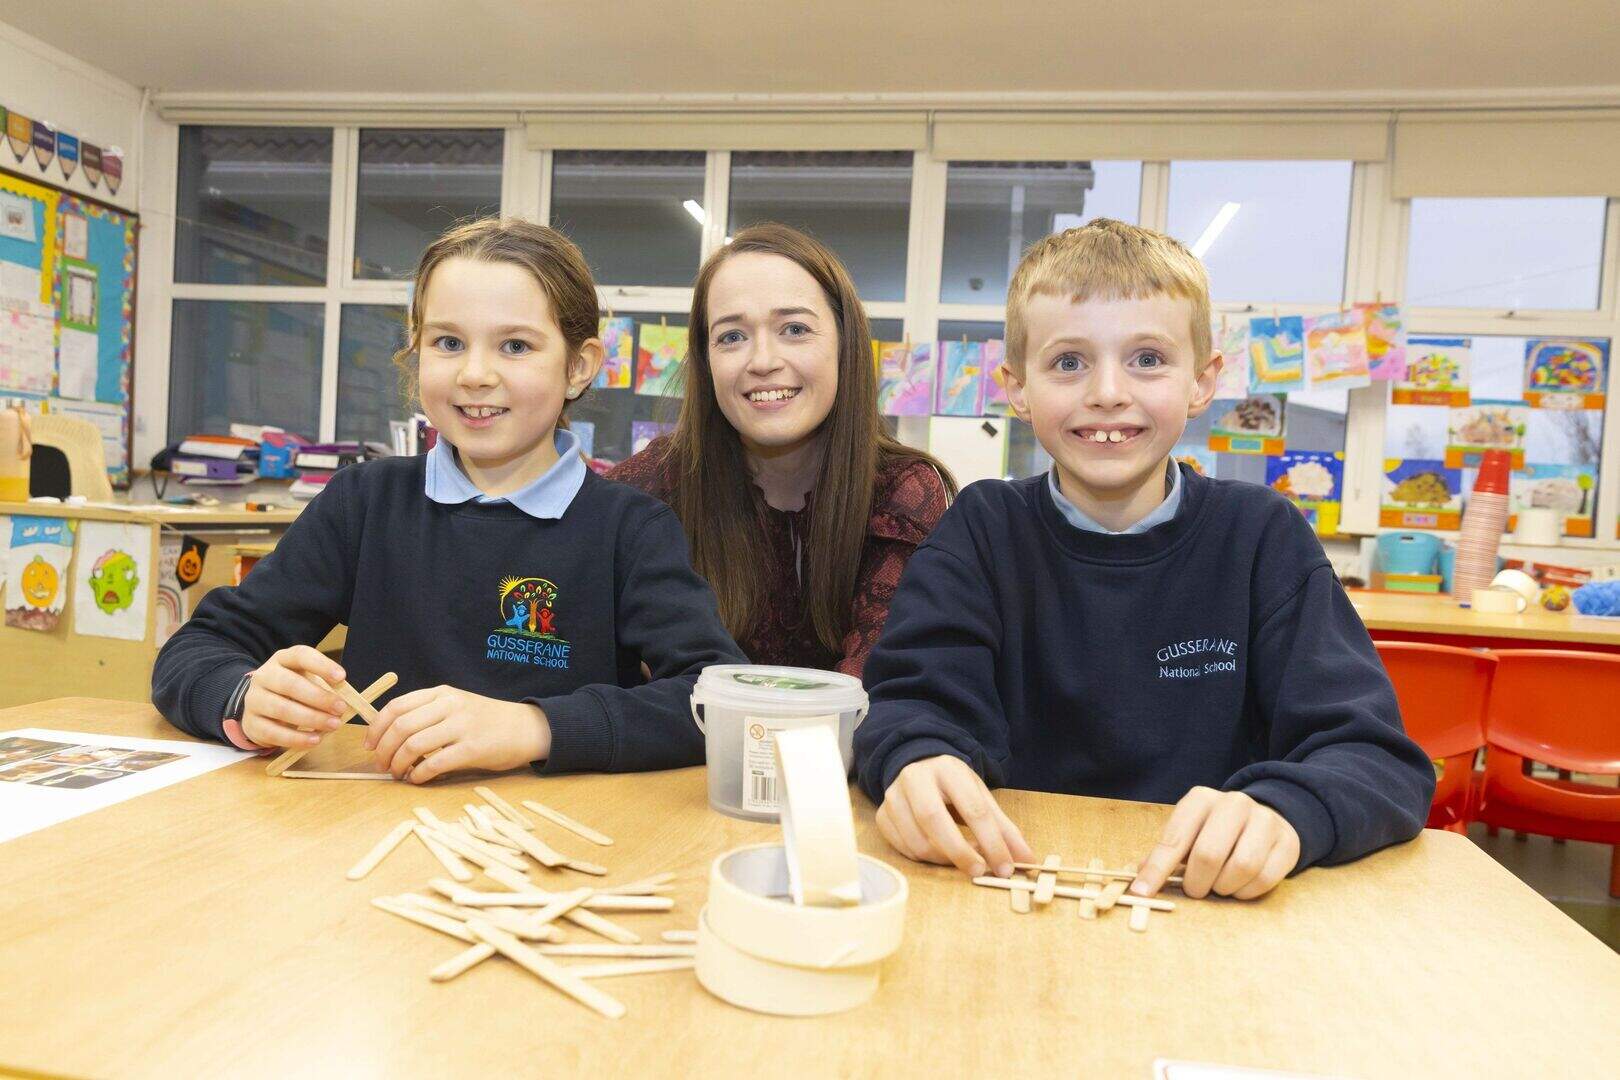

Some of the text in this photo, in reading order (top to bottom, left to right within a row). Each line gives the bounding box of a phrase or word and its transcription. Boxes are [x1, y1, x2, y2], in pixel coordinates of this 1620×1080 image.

[487, 634, 571, 659] GUSSERANE
[1156, 638, 1238, 662] GUSSERANE
[487, 649, 569, 669] NATIONAL SCHOOL
[1204, 659, 1236, 674] School
